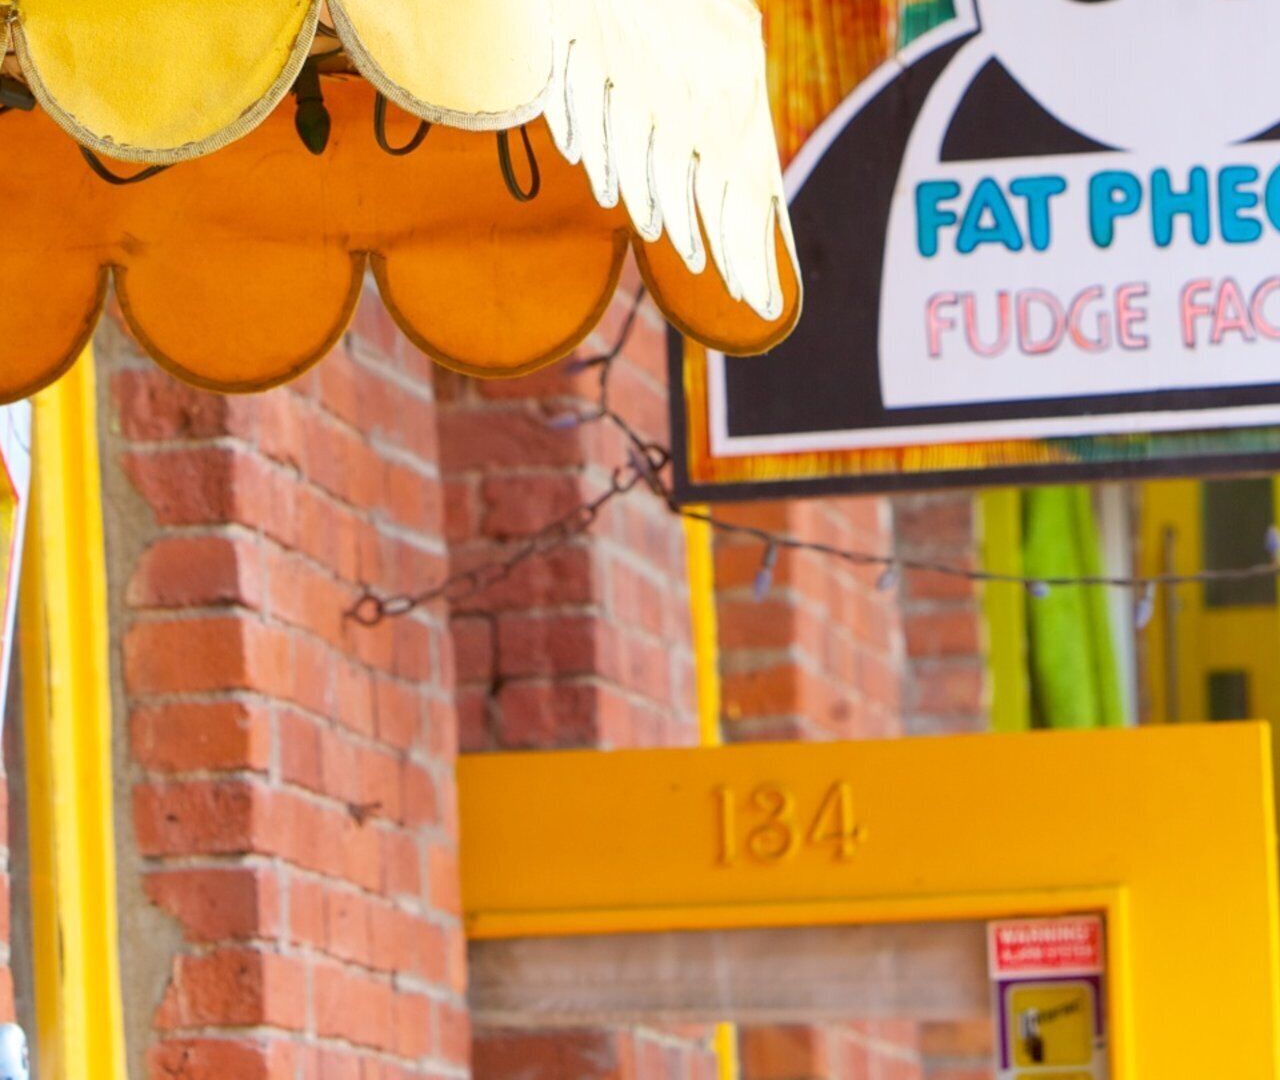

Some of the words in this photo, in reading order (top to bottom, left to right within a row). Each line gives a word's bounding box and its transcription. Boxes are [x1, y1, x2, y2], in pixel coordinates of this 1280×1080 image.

[915, 174, 1068, 258] FAT
[925, 281, 1150, 358] FUDGE
[710, 781, 867, 866] 134
